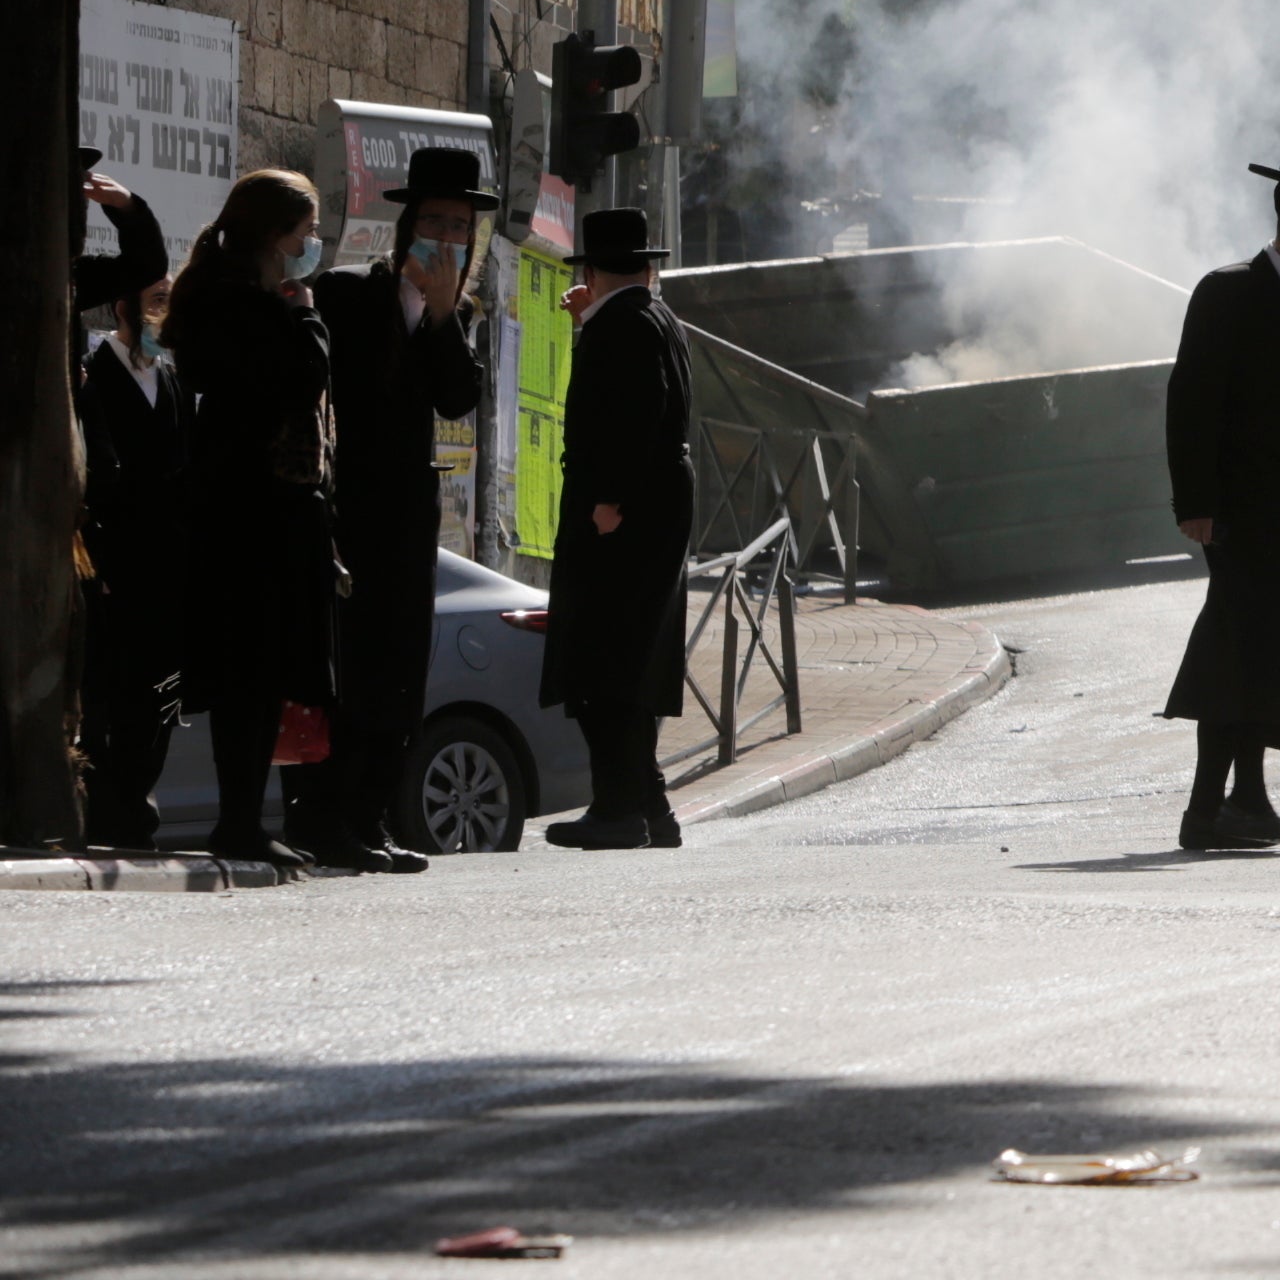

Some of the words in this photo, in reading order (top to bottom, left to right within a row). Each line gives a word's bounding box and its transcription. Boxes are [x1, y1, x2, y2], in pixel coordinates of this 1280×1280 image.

[125, 61, 174, 115] תעברי
[180, 66, 200, 119] אל
[206, 77, 232, 125] אנא
[107, 114, 141, 166] לא
[151, 122, 232, 180] בלבוש
[361, 136, 397, 169] GOOD
[348, 129, 361, 209] RENT
